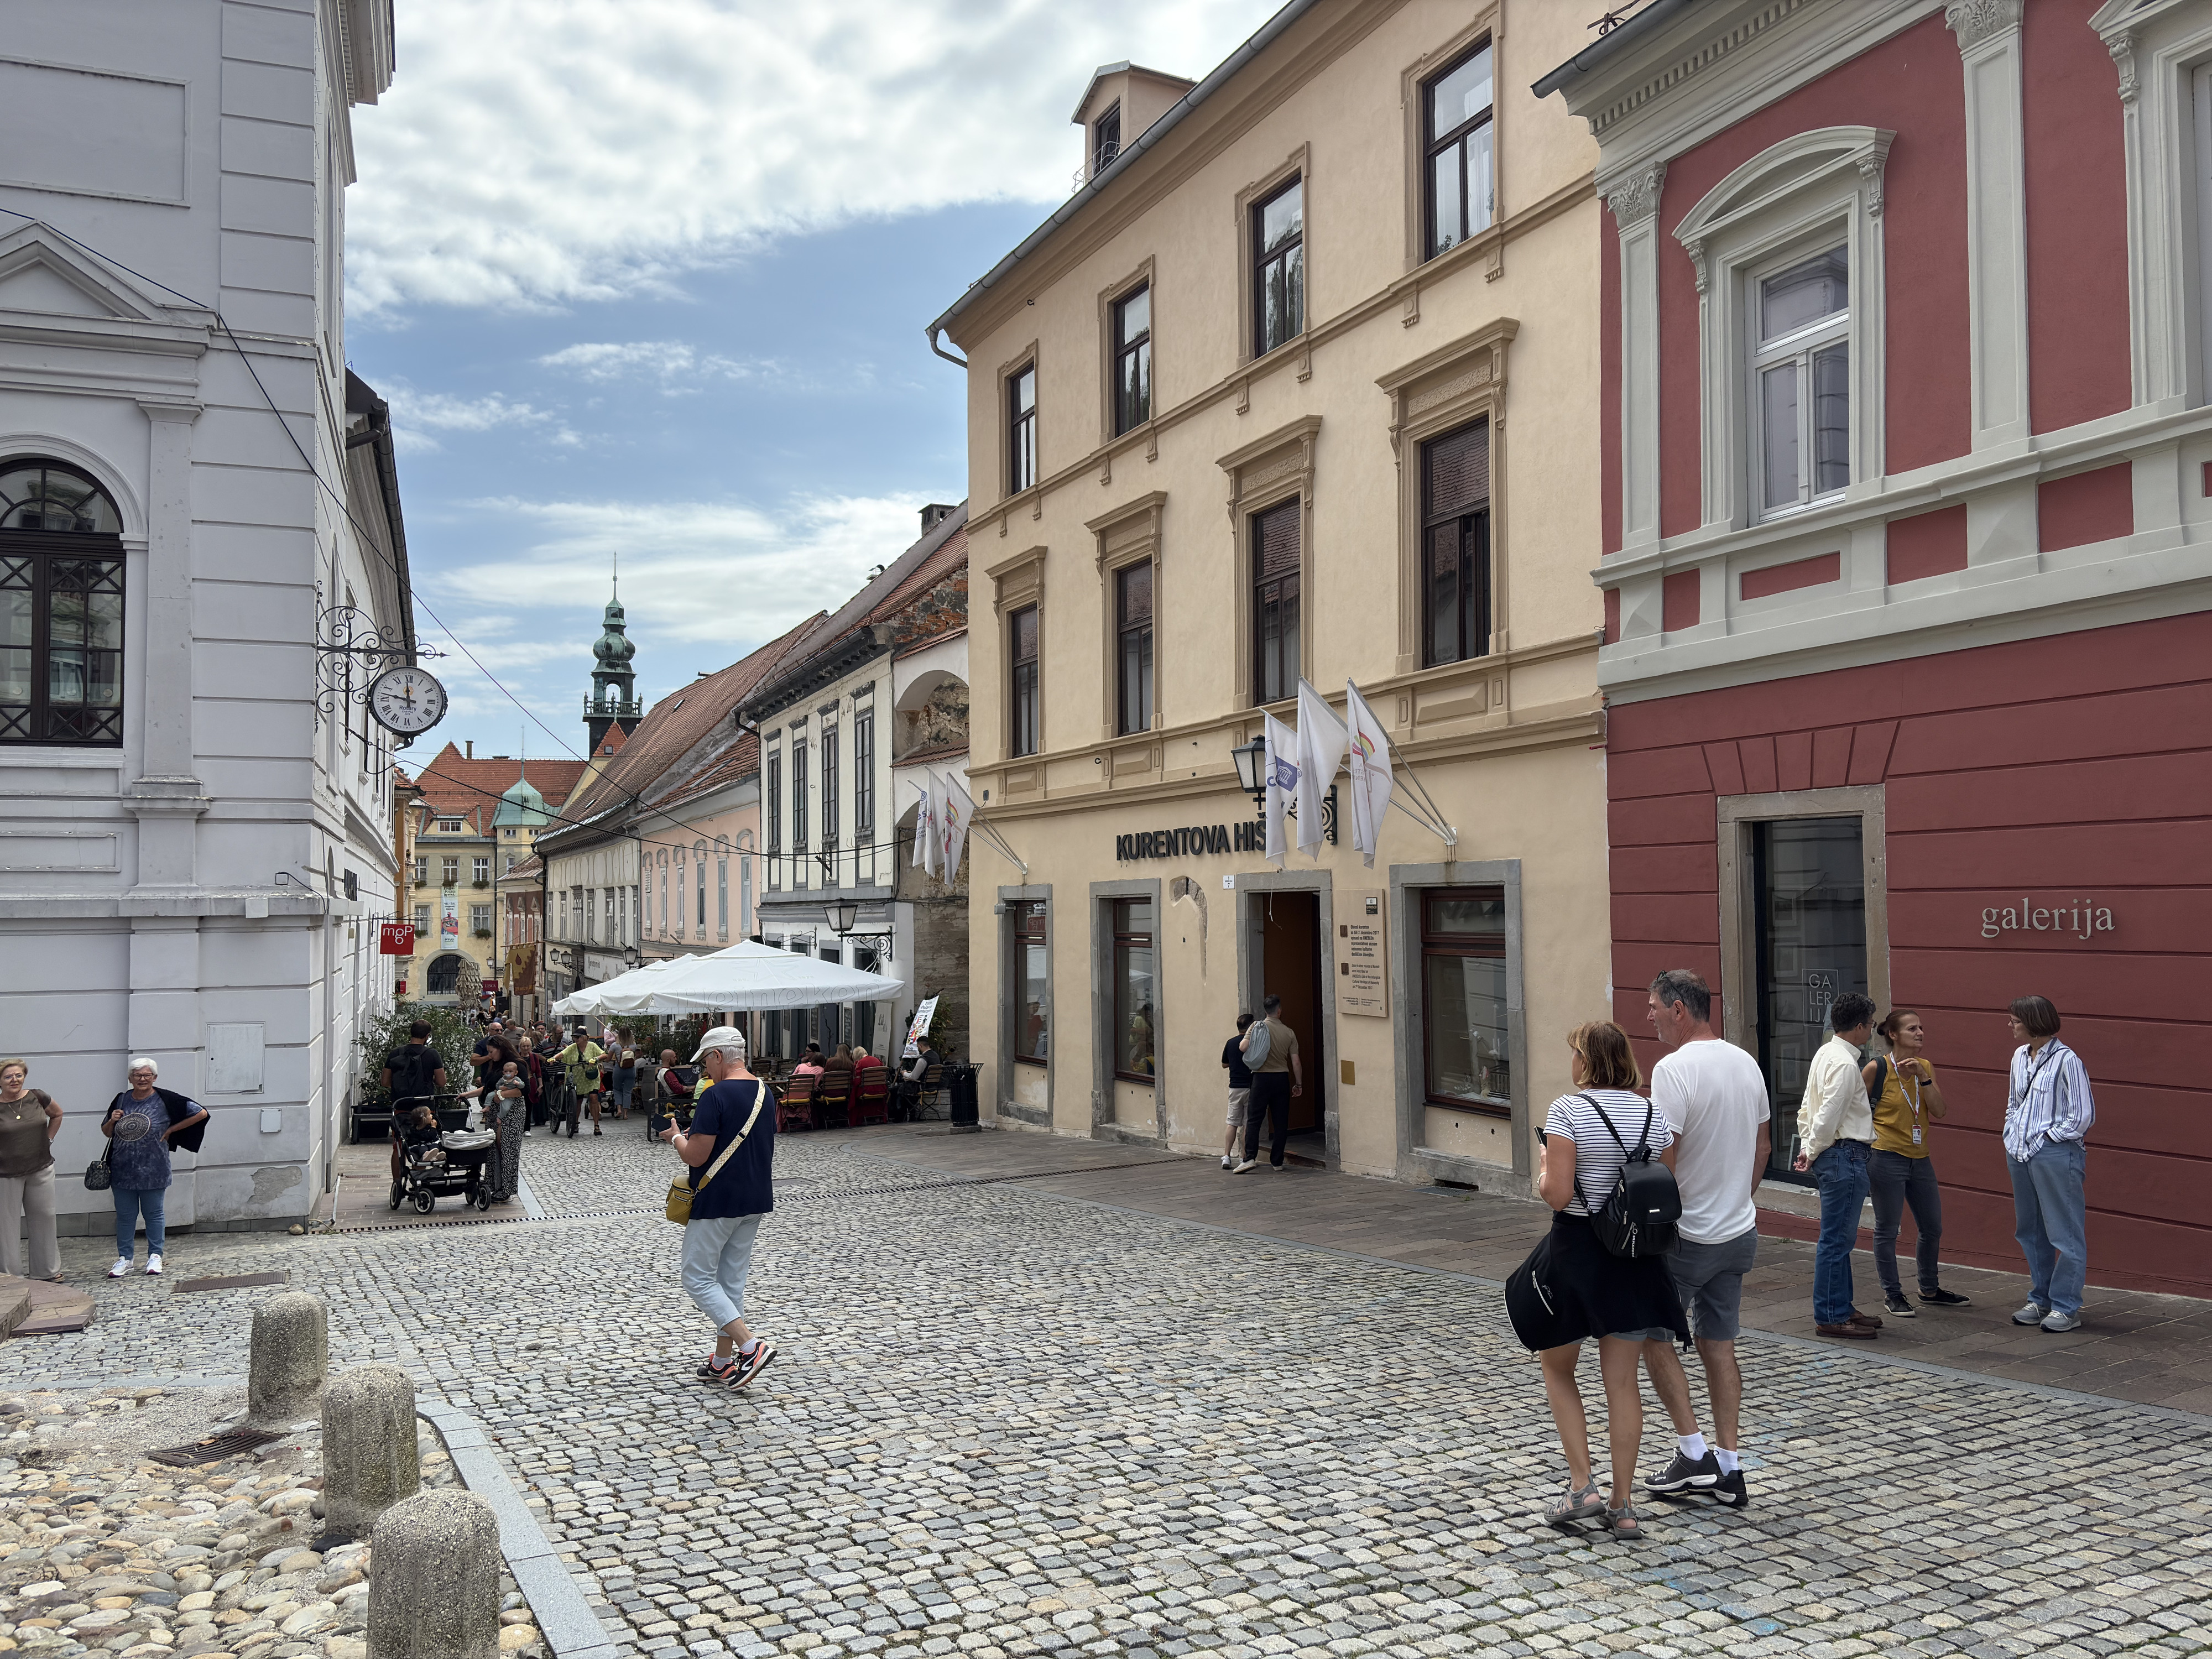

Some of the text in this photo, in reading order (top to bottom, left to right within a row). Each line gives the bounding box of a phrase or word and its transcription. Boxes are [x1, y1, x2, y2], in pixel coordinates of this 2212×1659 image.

[392, 676, 402, 686] XI
[405, 675, 413, 684] XII
[1116, 812, 1266, 860] KURENTOVA HIŠ
[1981, 897, 2116, 940] galerija
[1809, 974, 1832, 989] GA
[1809, 991, 1832, 1005] LER
[1810, 1008, 1825, 1022] IJ
